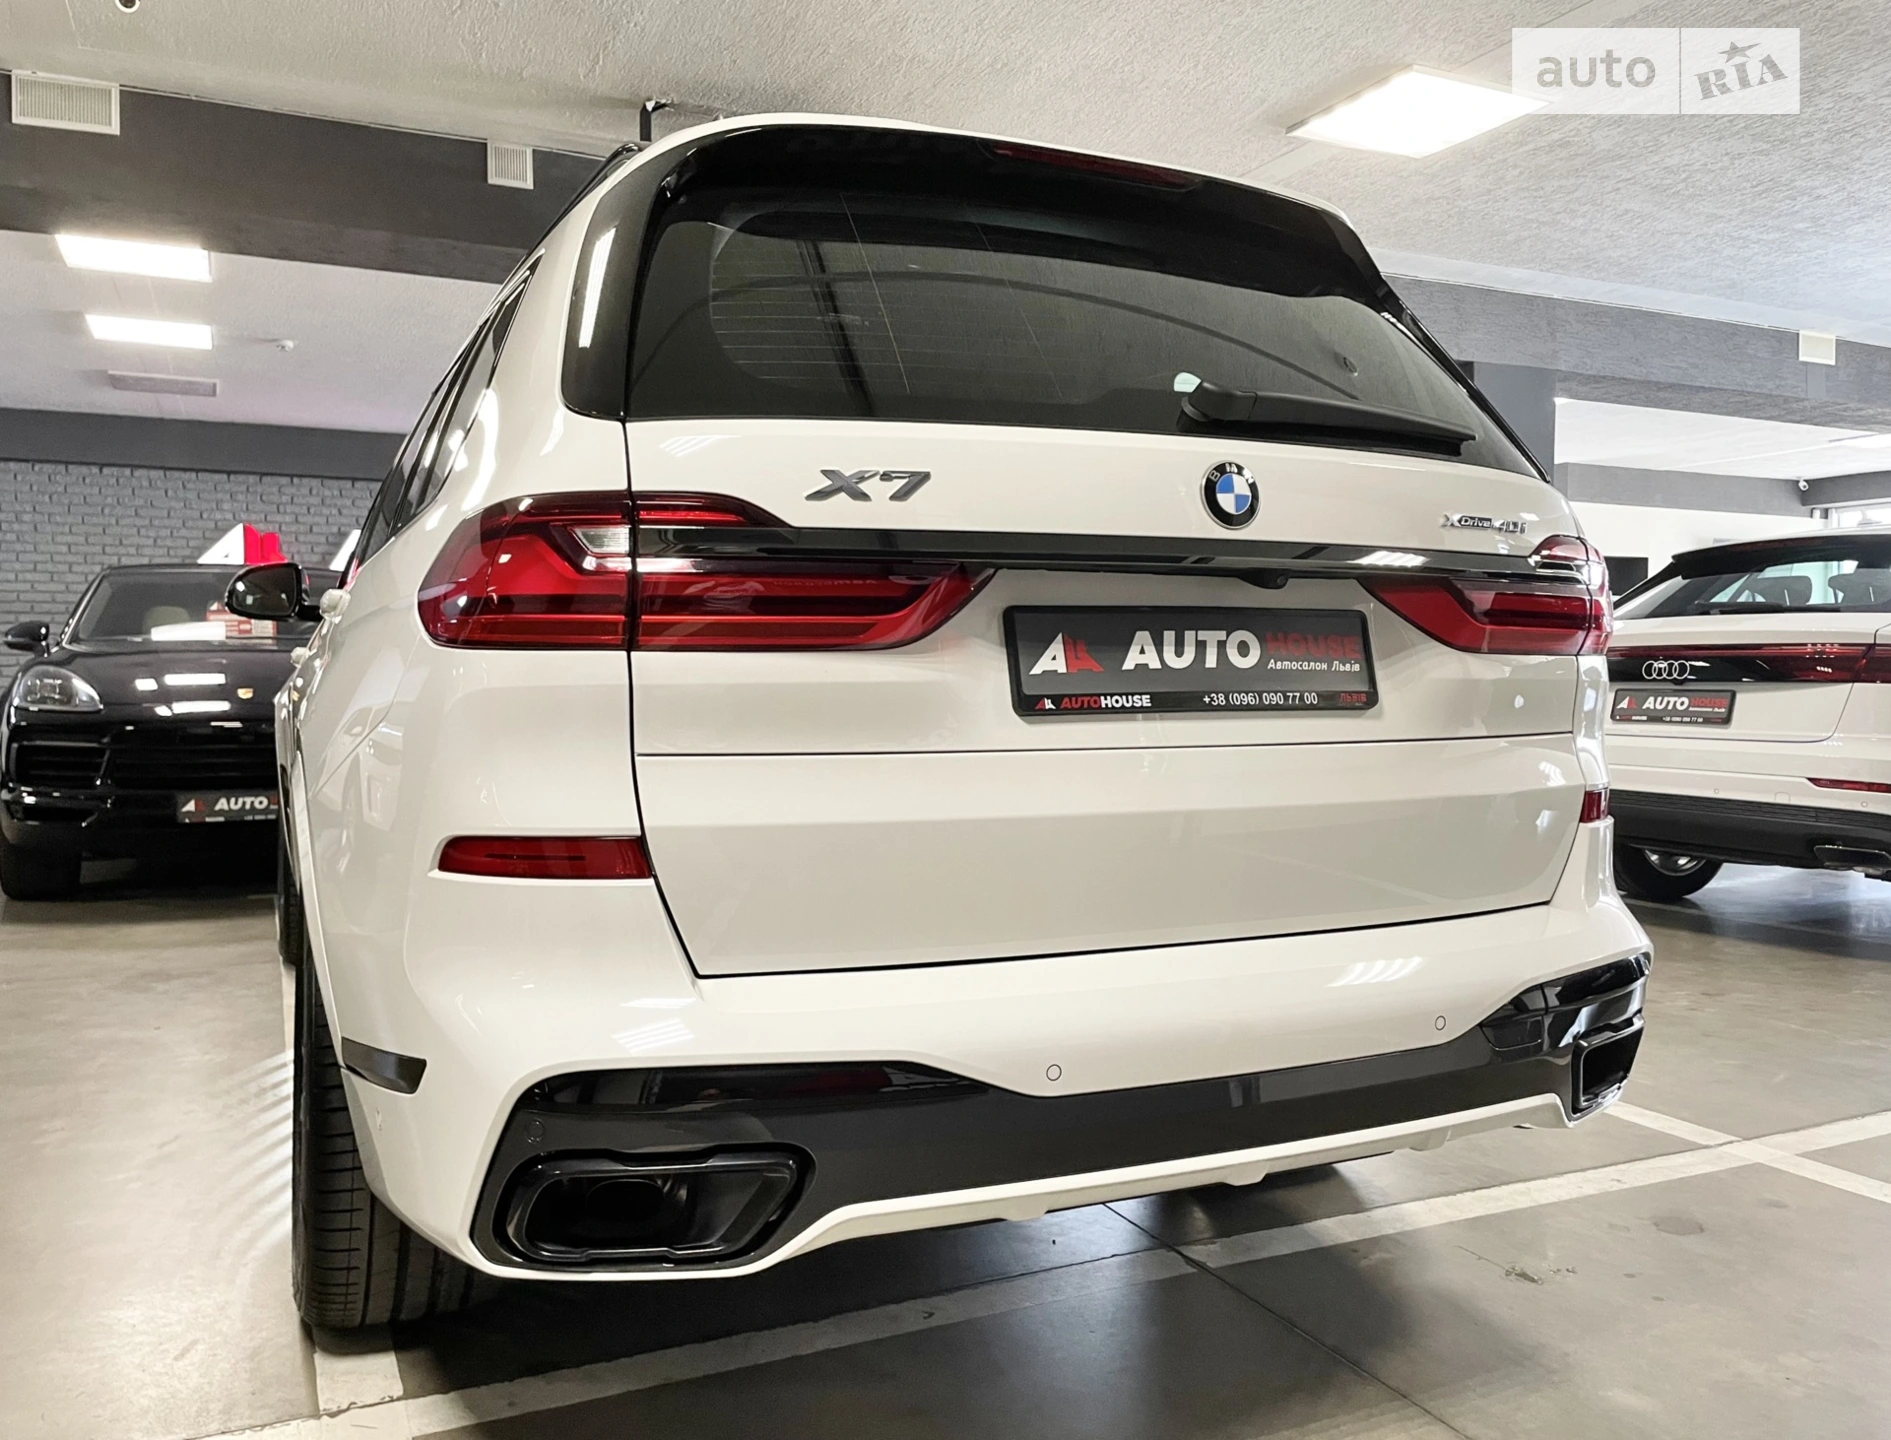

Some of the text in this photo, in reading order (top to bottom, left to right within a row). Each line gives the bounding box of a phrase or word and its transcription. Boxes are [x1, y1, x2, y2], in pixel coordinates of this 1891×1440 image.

[804, 469, 932, 502] X7
[1121, 629, 1262, 671] AUTO
[1265, 631, 1362, 659] HOUSE
[1267, 658, 1361, 672] Автосалон Львів
[1060, 694, 1152, 709] AUTOHOUSE
[1203, 692, 1318, 706] +38 (096) 090 77 00
[1642, 696, 1689, 711] AUTO
[214, 796, 269, 811] AUTO
